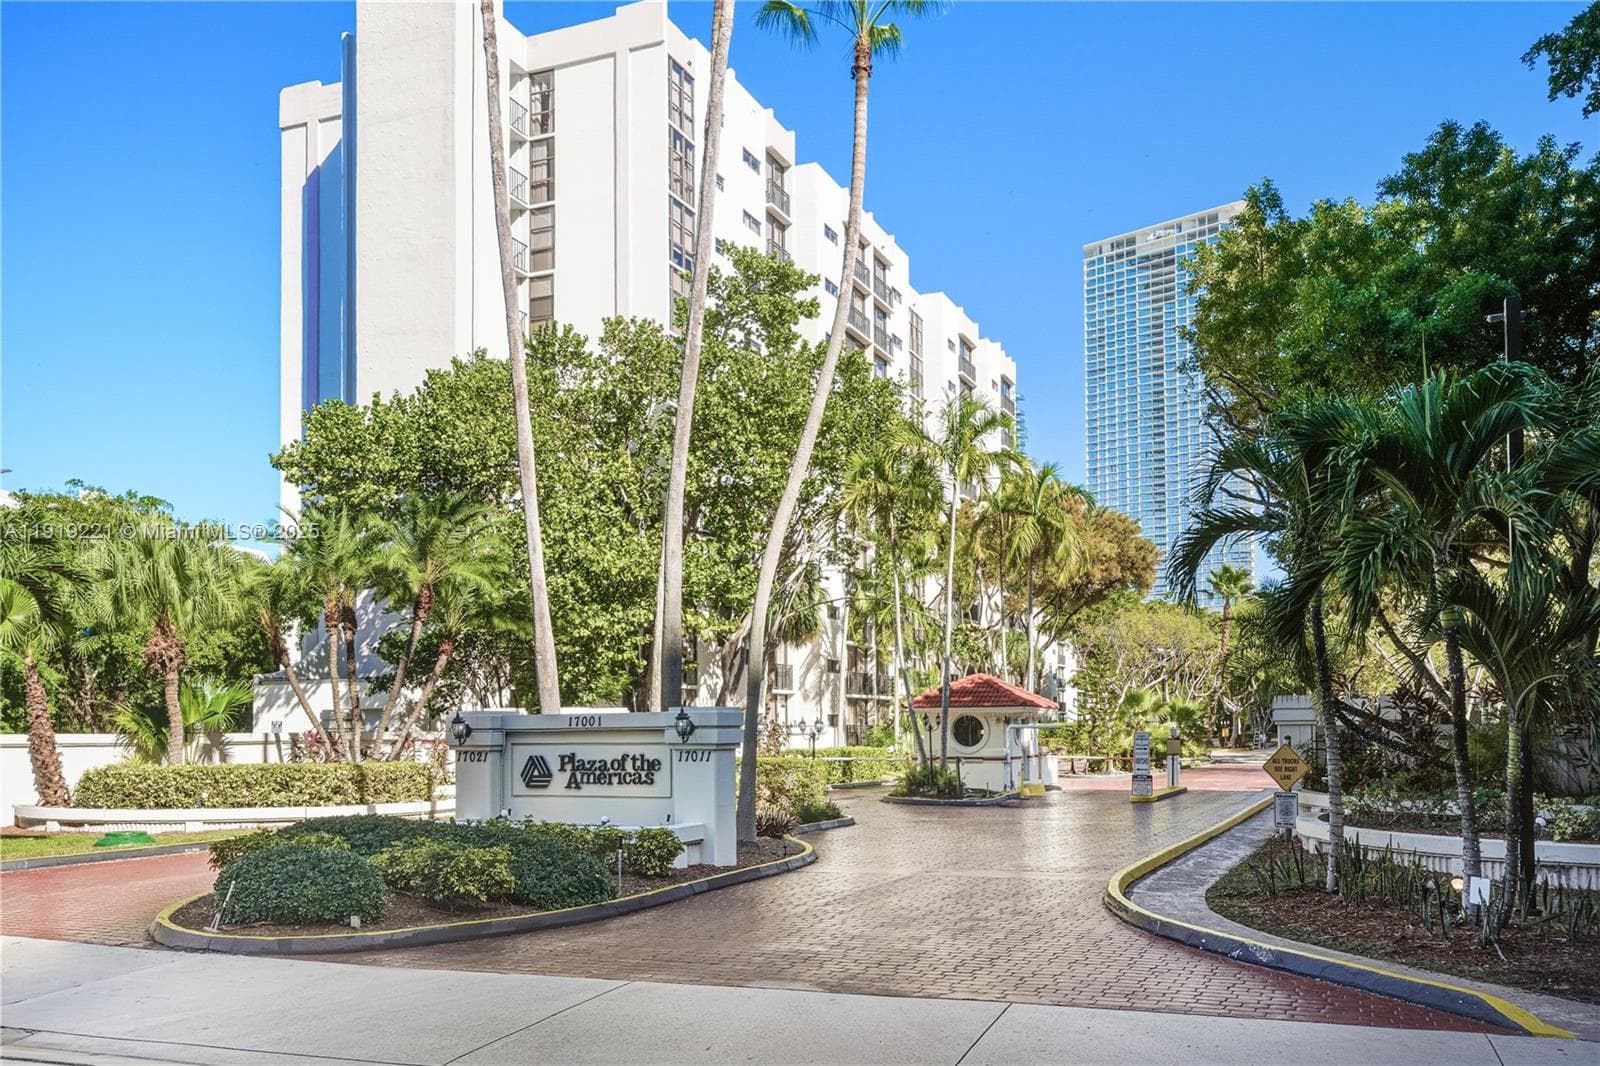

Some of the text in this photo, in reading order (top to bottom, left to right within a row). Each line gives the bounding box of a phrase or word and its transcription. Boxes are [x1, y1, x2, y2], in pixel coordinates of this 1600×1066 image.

[568, 715, 602, 727] 17001
[456, 751, 489, 763] 17021
[558, 752, 662, 772] Plaza of the
[678, 750, 712, 762] 17011
[564, 770, 655, 790] Americas
